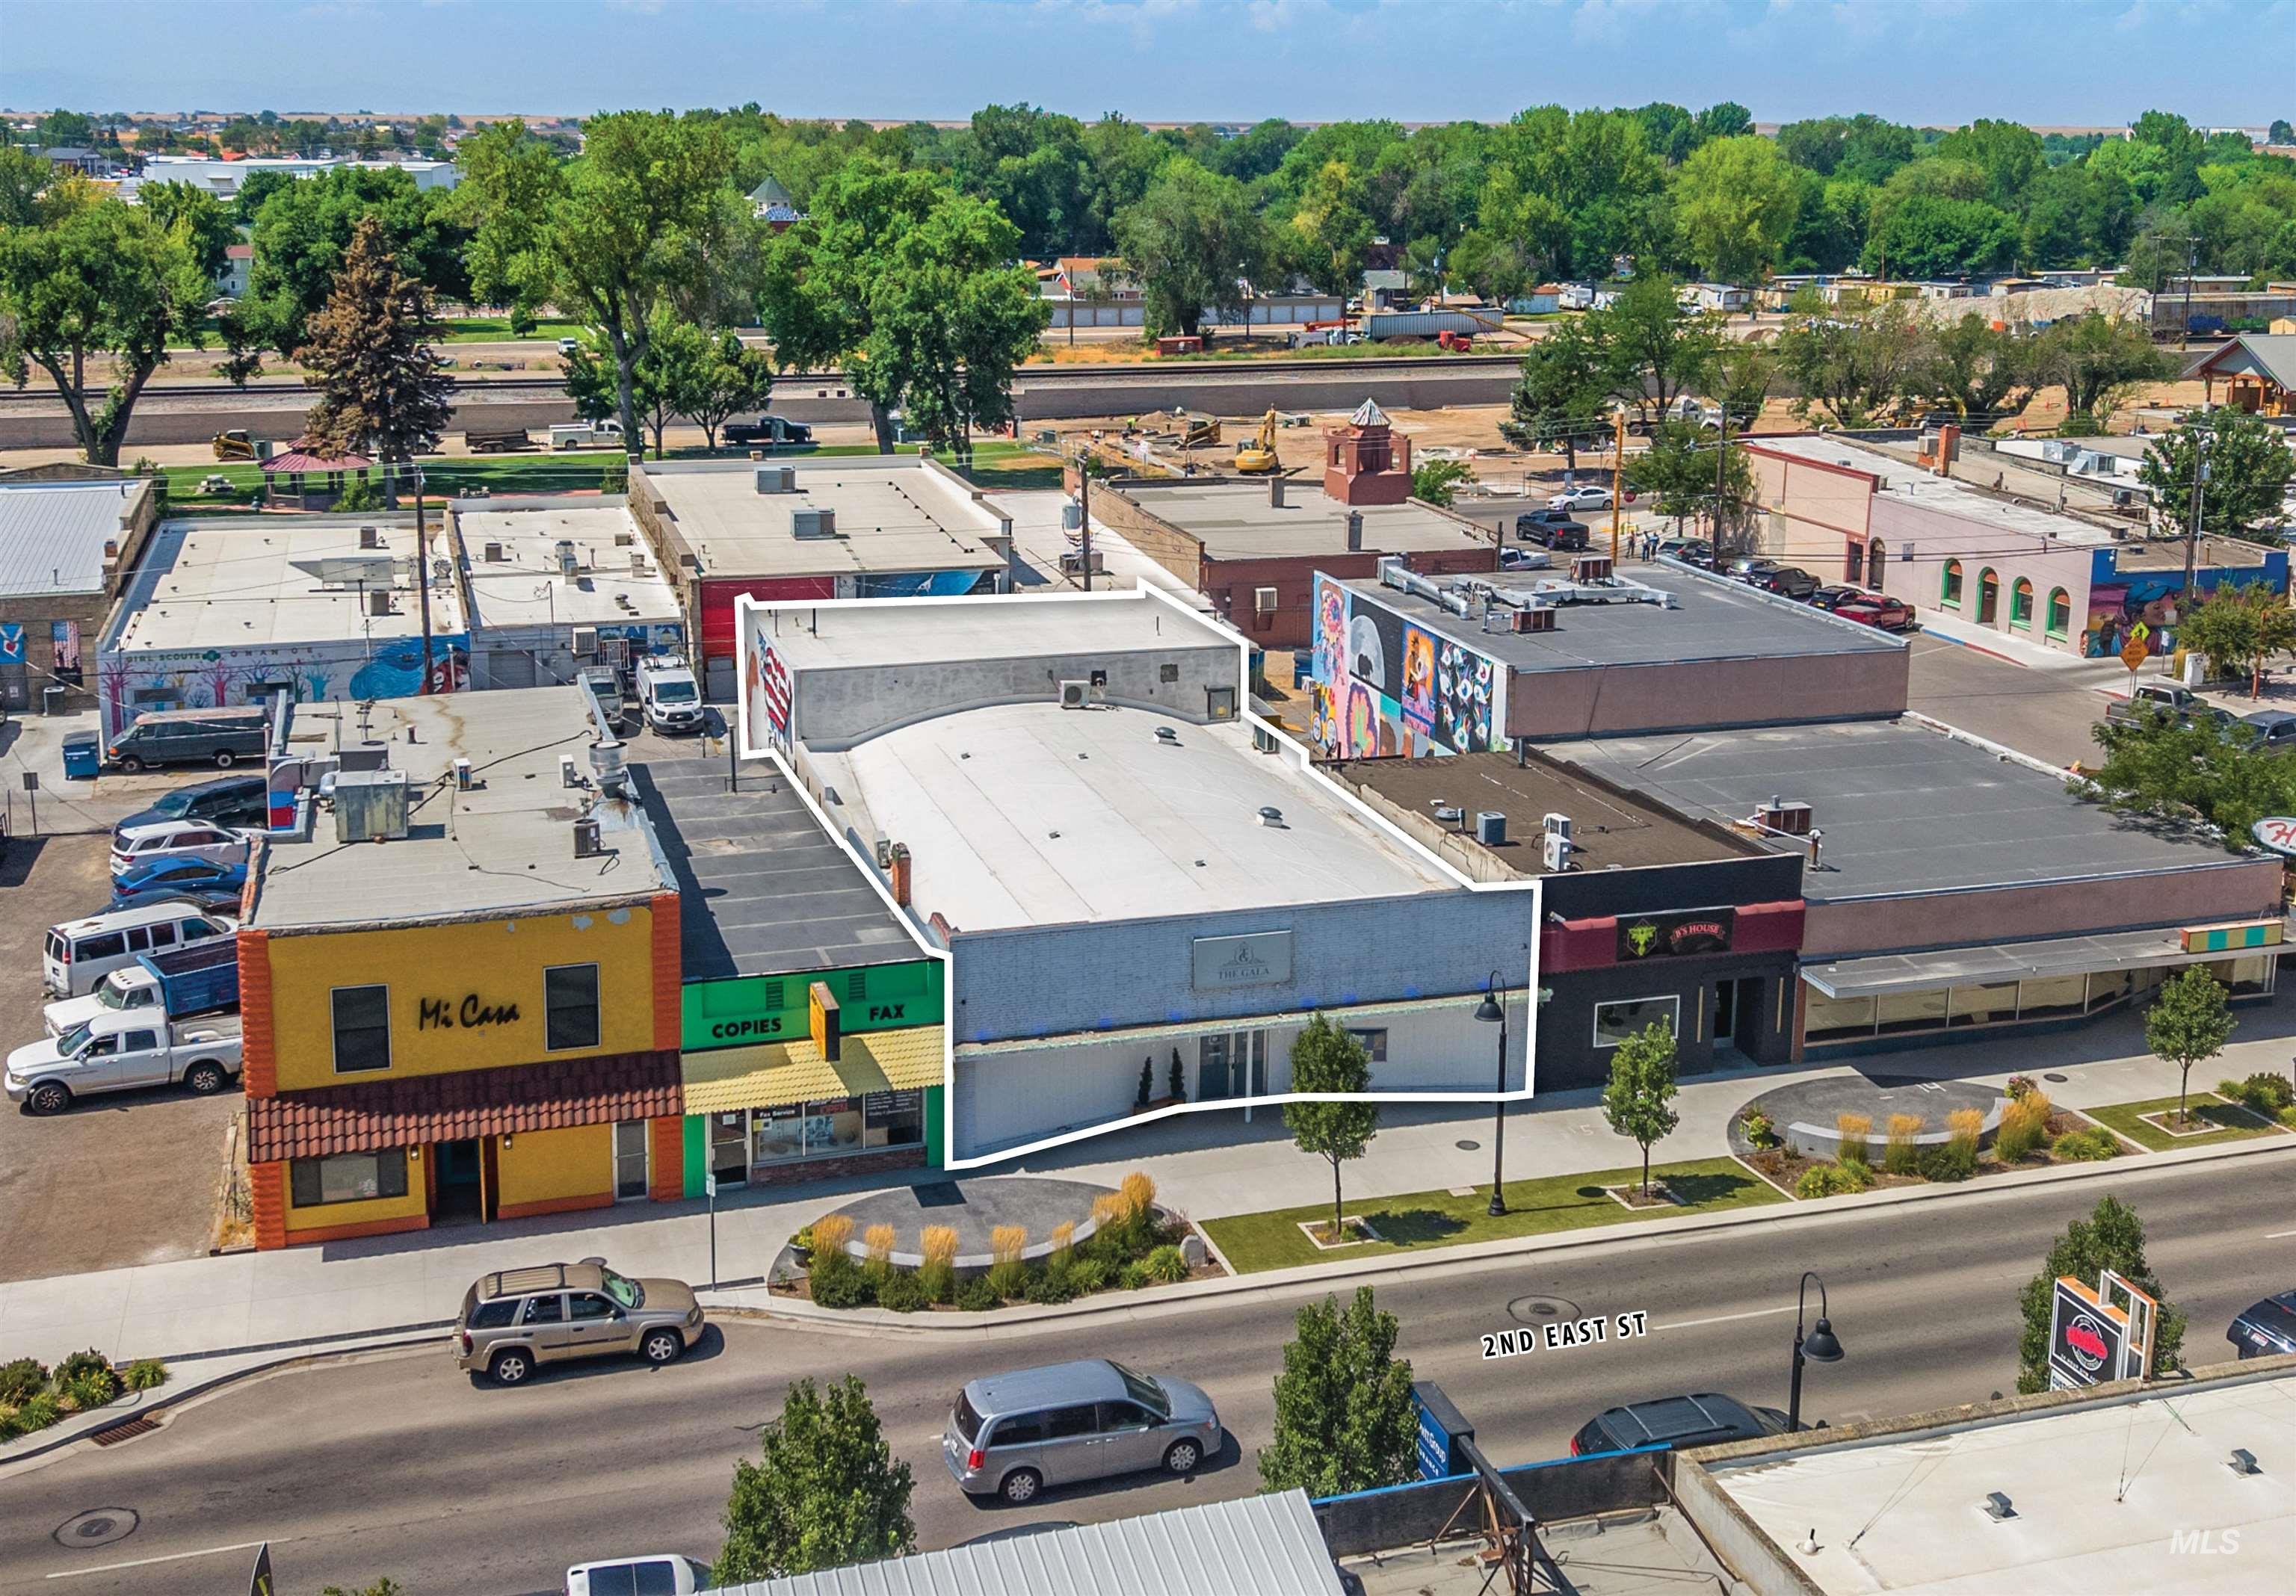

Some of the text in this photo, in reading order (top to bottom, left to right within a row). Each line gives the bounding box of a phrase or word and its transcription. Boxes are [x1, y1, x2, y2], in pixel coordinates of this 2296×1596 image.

[126, 652, 200, 664] GIRL SCOUTS
[1689, 924, 1719, 934] HOUSE
[1219, 967, 1270, 980] THE GALA
[419, 994, 520, 1031] Mi Casa
[868, 1004, 905, 1022] FAX
[712, 1017, 782, 1039] COPIES
